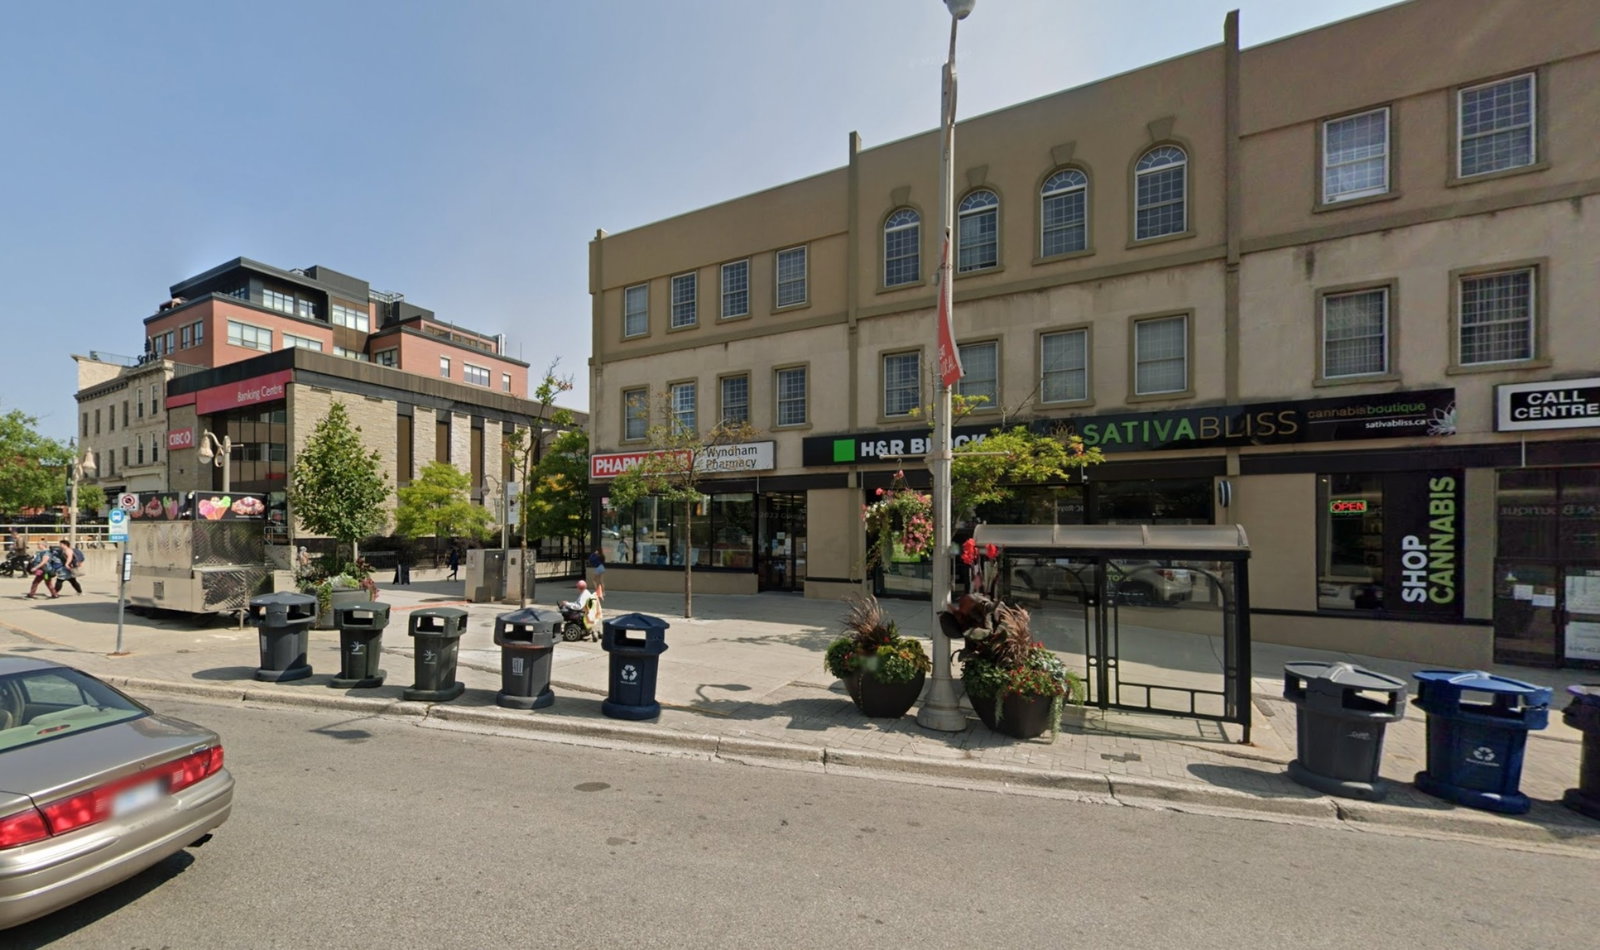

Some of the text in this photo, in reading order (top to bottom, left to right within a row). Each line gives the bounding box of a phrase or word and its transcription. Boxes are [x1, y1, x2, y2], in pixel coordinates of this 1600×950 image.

[237, 384, 283, 403] Banking Centre
[1527, 390, 1586, 405] CALL
[1514, 403, 1600, 419] CENTRE
[1365, 418, 1426, 429] sativabliss.ca
[169, 431, 184, 446] CIBC
[860, 433, 987, 457] H&R BLCK
[706, 446, 758, 459] Wyndham
[706, 459, 757, 470] Pharmacy
[1331, 502, 1365, 511] OPEN
[1428, 476, 1456, 604] CANNABIS
[1402, 535, 1427, 603] SHOP
